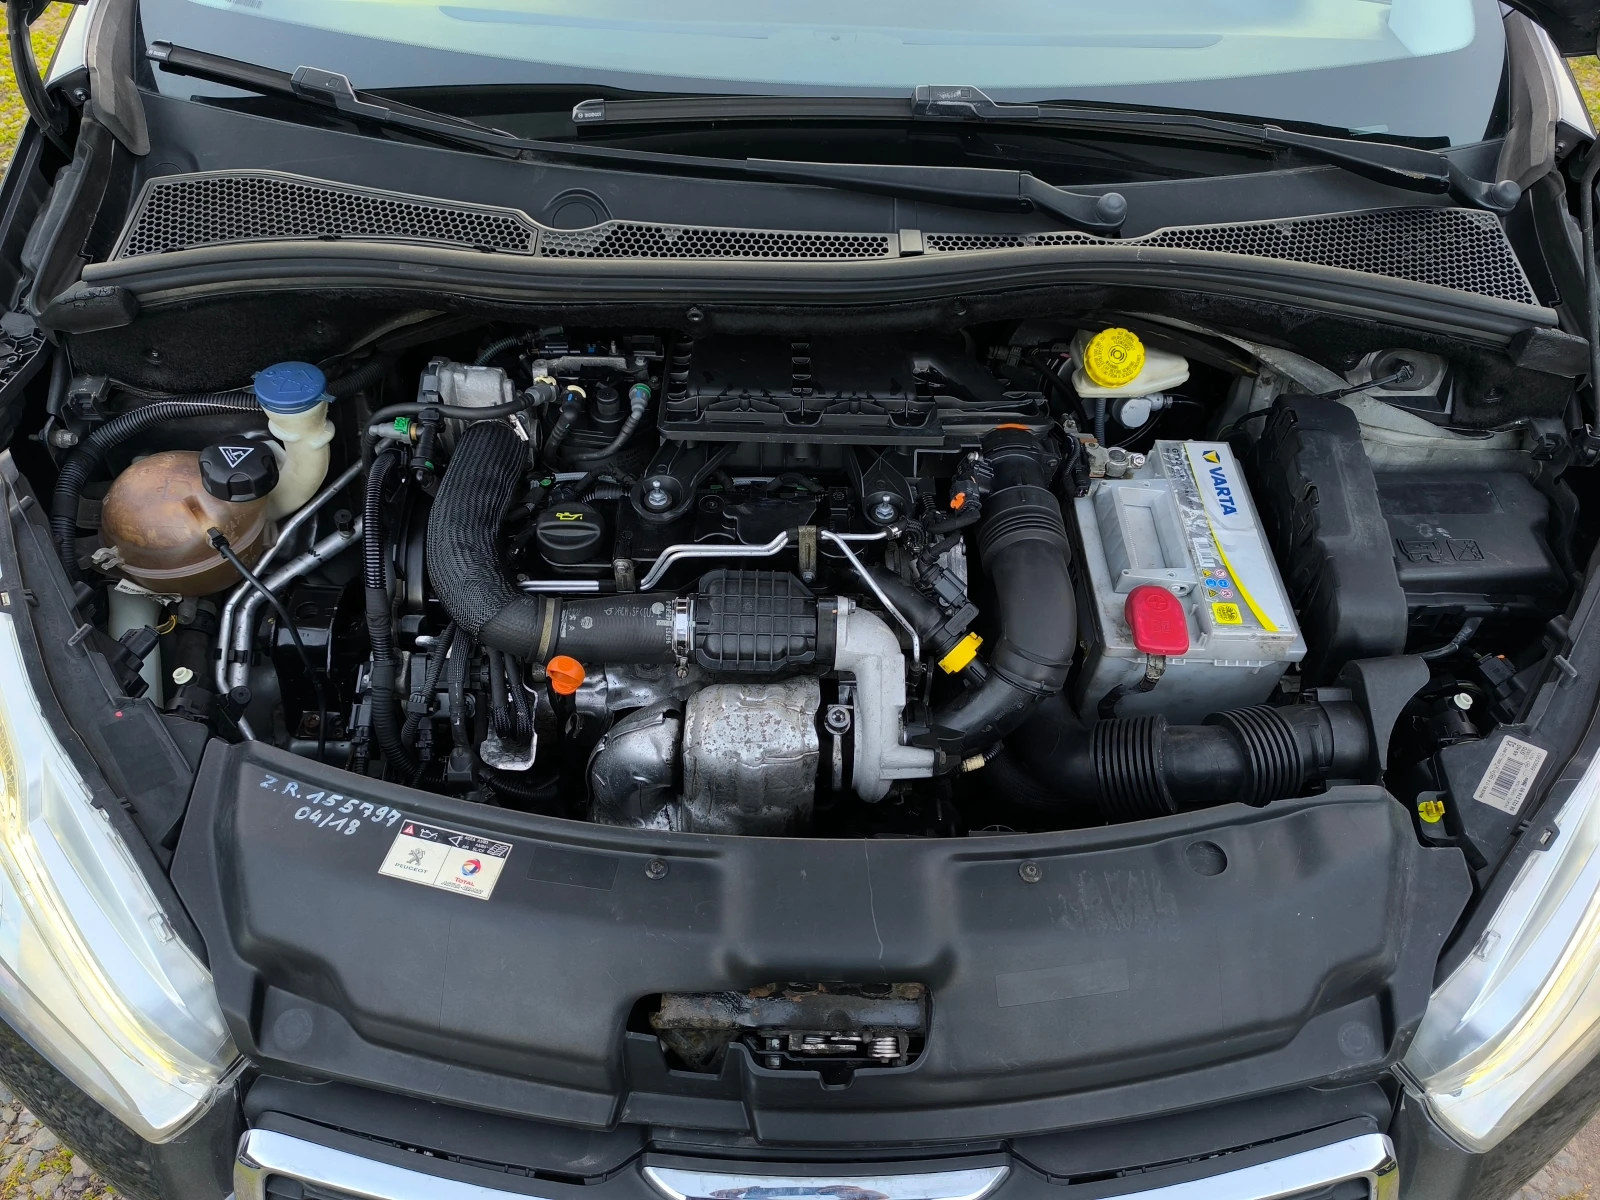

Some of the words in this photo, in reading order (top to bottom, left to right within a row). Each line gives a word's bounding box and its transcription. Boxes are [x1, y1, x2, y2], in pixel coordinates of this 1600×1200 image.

[1208, 466, 1237, 516] VARTA
[294, 806, 361, 835] 04/18
[306, 791, 402, 828] 155797
[394, 862, 428, 874] PEUGEOT
[454, 876, 475, 887] TOTAL
